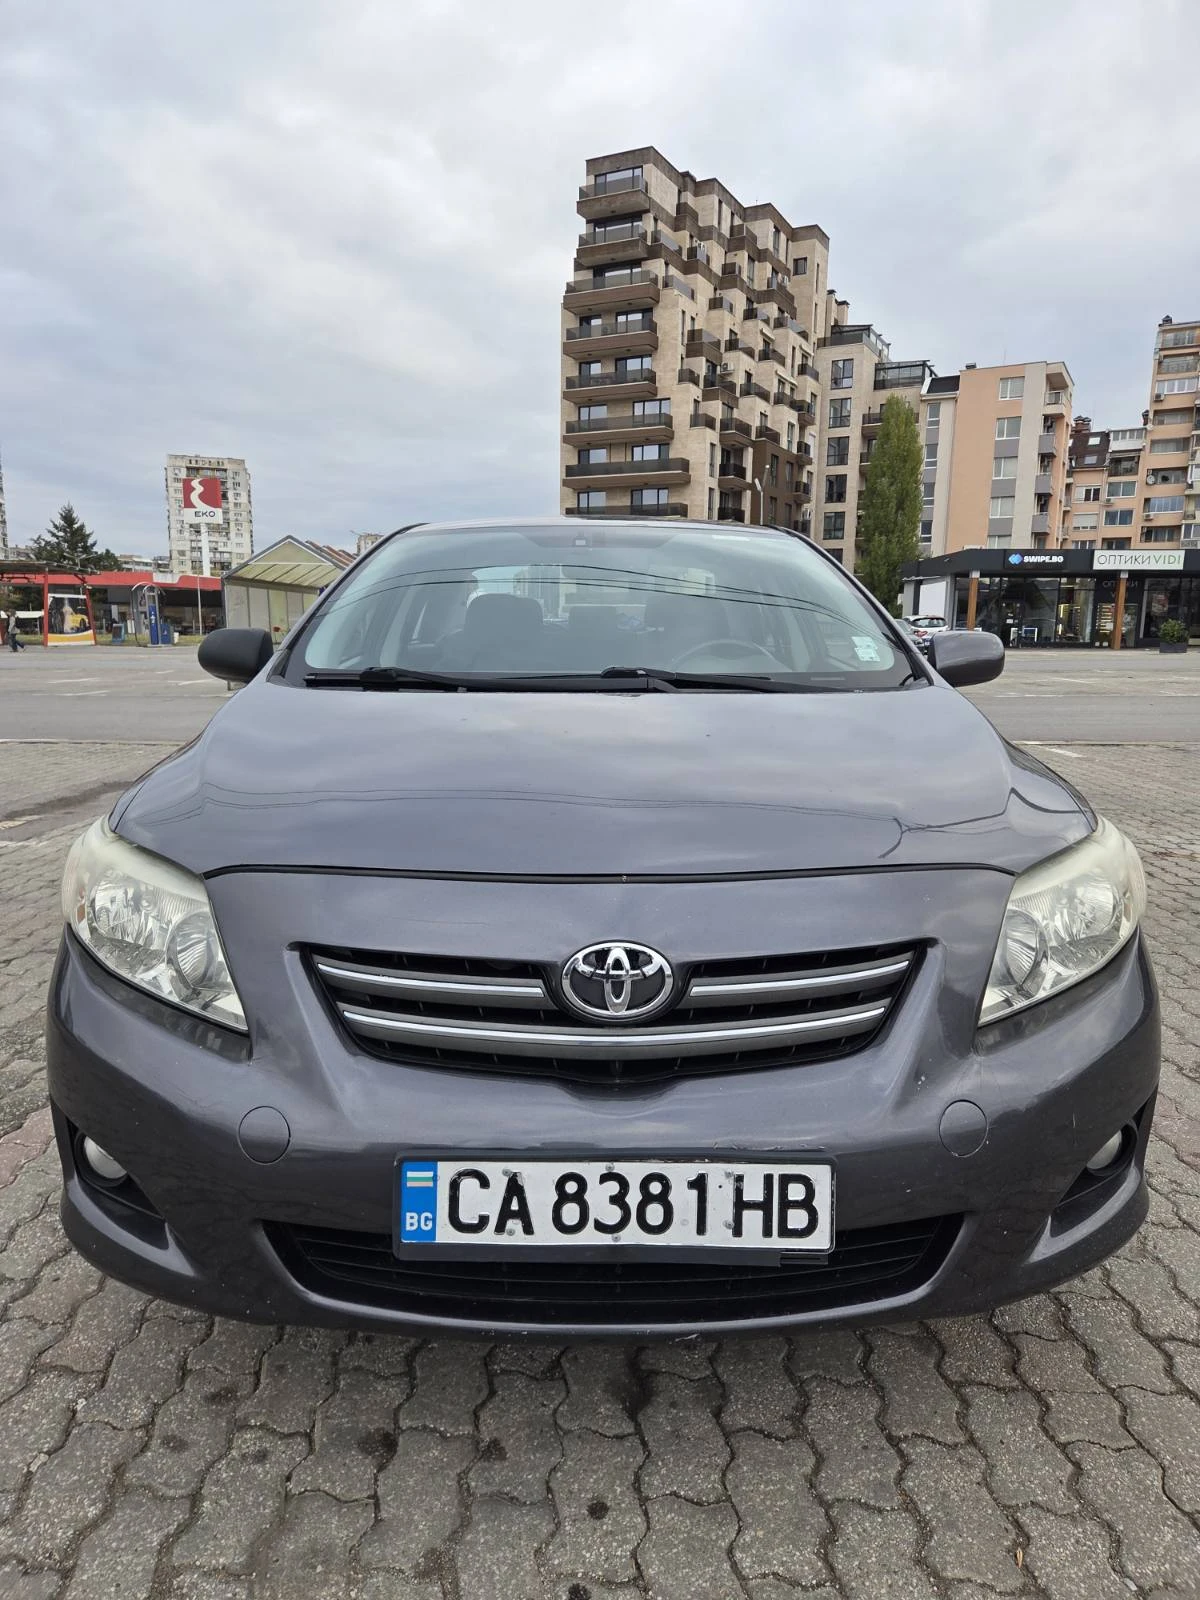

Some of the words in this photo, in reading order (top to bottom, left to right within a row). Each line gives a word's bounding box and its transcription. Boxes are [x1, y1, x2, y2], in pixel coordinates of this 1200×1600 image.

[194, 510, 216, 518] EKO
[1097, 554, 1151, 565] ОПТИКИ
[1153, 554, 1181, 565] VIDI
[448, 1168, 535, 1235] CA
[551, 1171, 709, 1236] 8381
[732, 1173, 819, 1239] HB
[405, 1211, 433, 1231] BG
